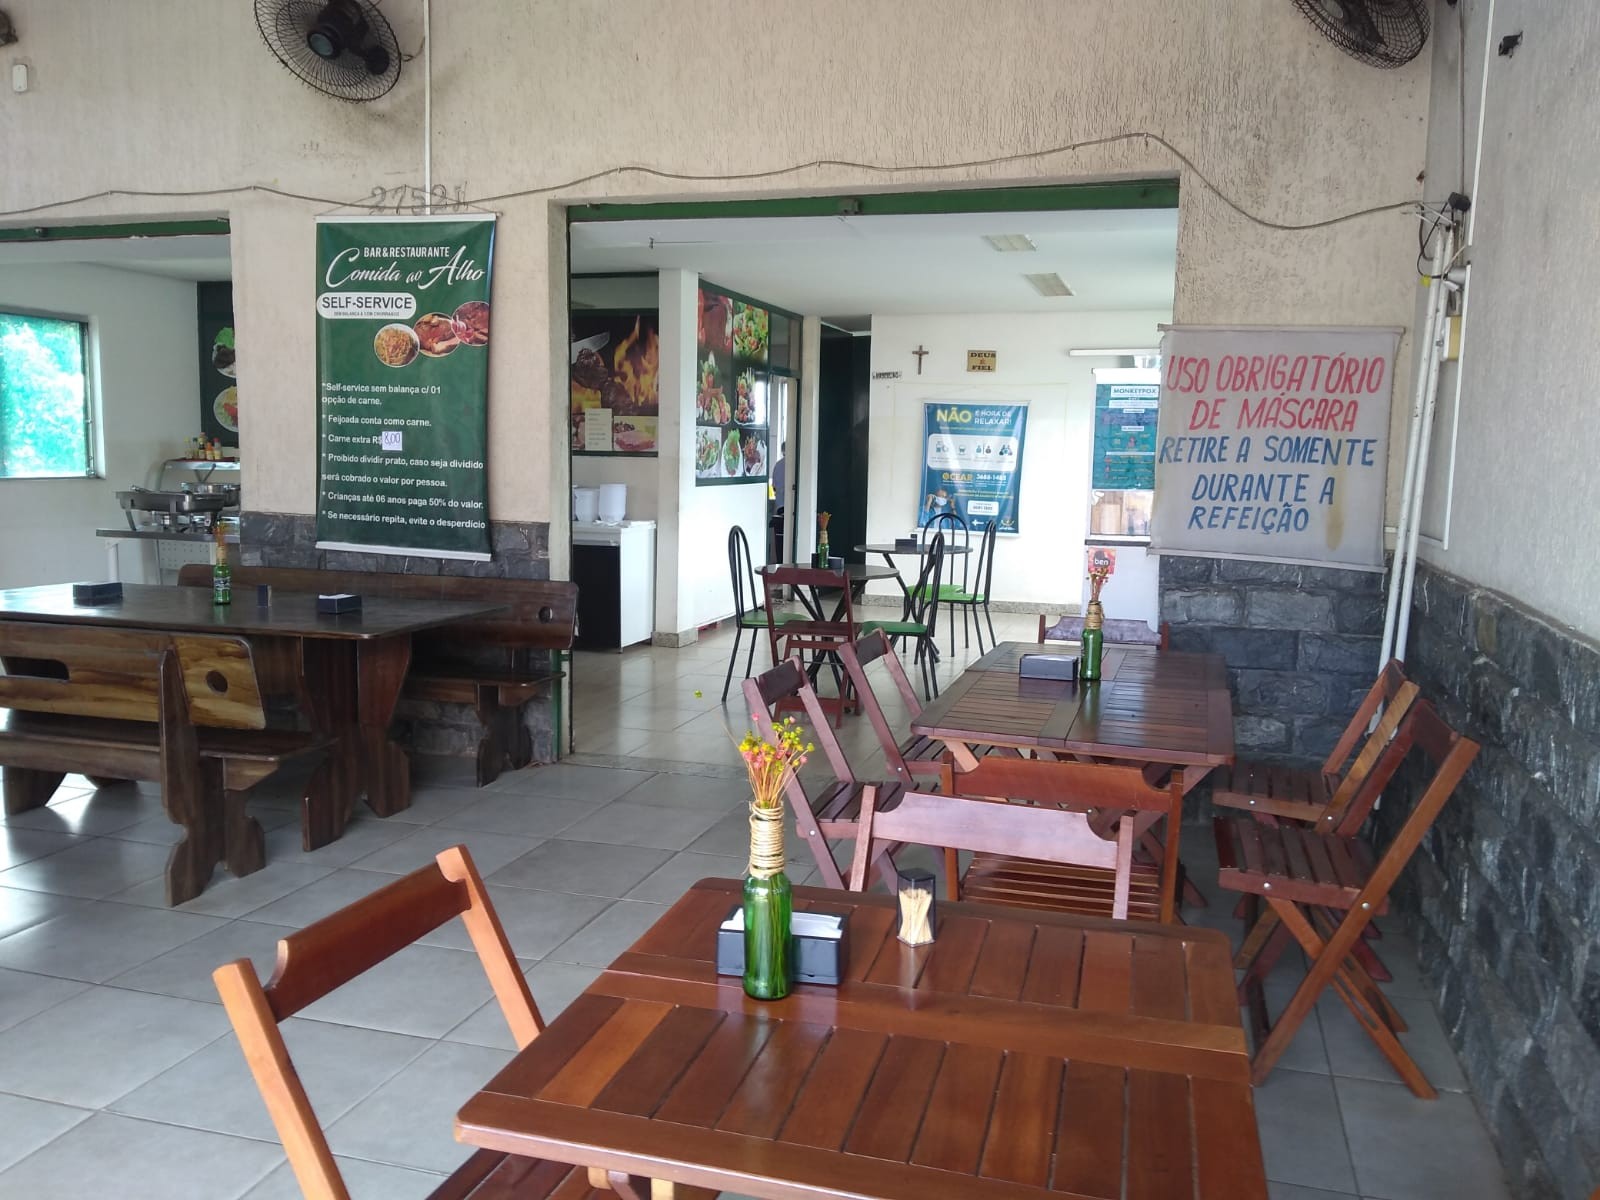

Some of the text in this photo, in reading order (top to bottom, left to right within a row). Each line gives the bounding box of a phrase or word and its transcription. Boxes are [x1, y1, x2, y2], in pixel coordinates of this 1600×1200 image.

[364, 246, 450, 258] BAR&RESTAURANTE
[326, 245, 485, 289] Comida ao Alho
[322, 297, 412, 309] SELF-SERVICE
[1166, 352, 1385, 394] USO OBRIGATÓRIO
[388, 384, 419, 395] balança
[421, 385, 429, 394] c/
[431, 385, 441, 394] 01
[322, 396, 382, 406] opção de carne.
[936, 407, 972, 423] NÃO
[1188, 392, 1359, 432] DE MÁSCARA
[328, 415, 431, 427] Feijoada conta como carne.
[328, 434, 350, 442] Carne
[352, 435, 371, 443] extra
[1158, 435, 1378, 466] RETIRE A SOMENTE
[328, 453, 483, 469] Proibido dividir prato, caso seja dividido
[322, 472, 340, 481] será
[341, 473, 371, 483] cobrado
[379, 475, 399, 484] valor
[401, 478, 415, 487] por
[416, 479, 447, 487] pessoa.
[1191, 473, 1335, 505] DURANTE A
[328, 491, 484, 509] Crianças até 06 anos paga 50% do valor.
[327, 510, 337, 519] Se
[339, 511, 381, 522] necessário
[381, 515, 407, 525] repita,
[409, 517, 427, 526] evite
[436, 518, 486, 529] desperdício
[1187, 503, 1310, 535] REFEIÇÃO
